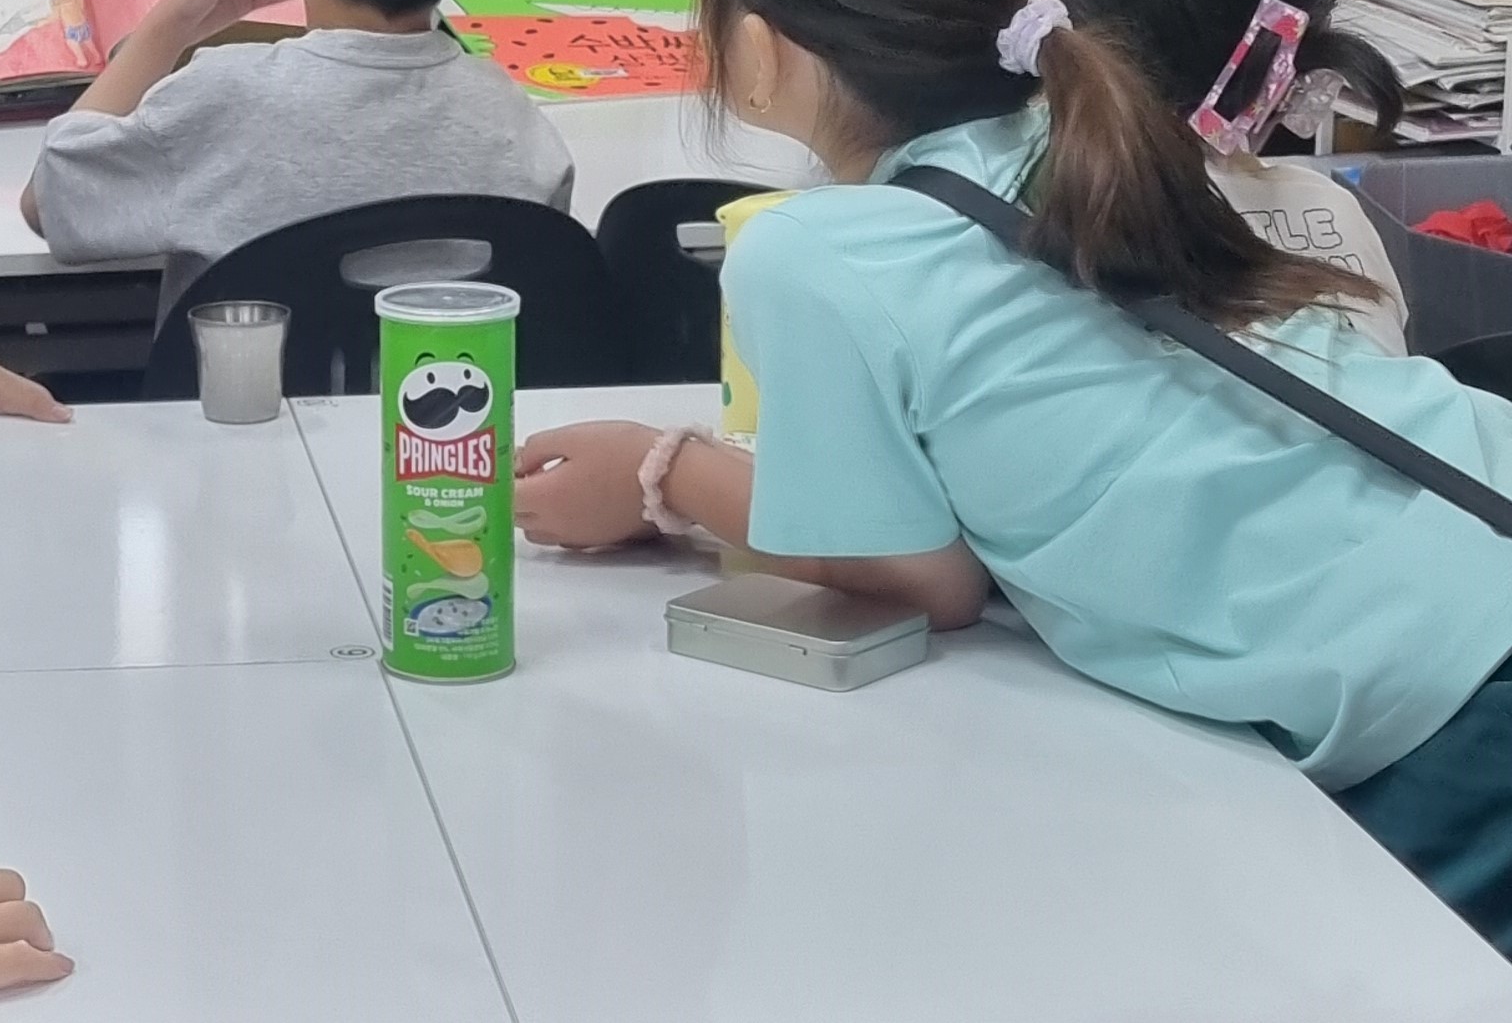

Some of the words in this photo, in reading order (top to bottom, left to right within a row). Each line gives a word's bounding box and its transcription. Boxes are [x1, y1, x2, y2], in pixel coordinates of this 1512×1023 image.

[399, 433, 492, 477] PRINGLES
[406, 485, 438, 498] SOUR
[441, 487, 484, 499] CREAM
[425, 498, 432, 506] &
[433, 499, 465, 508] ONION
